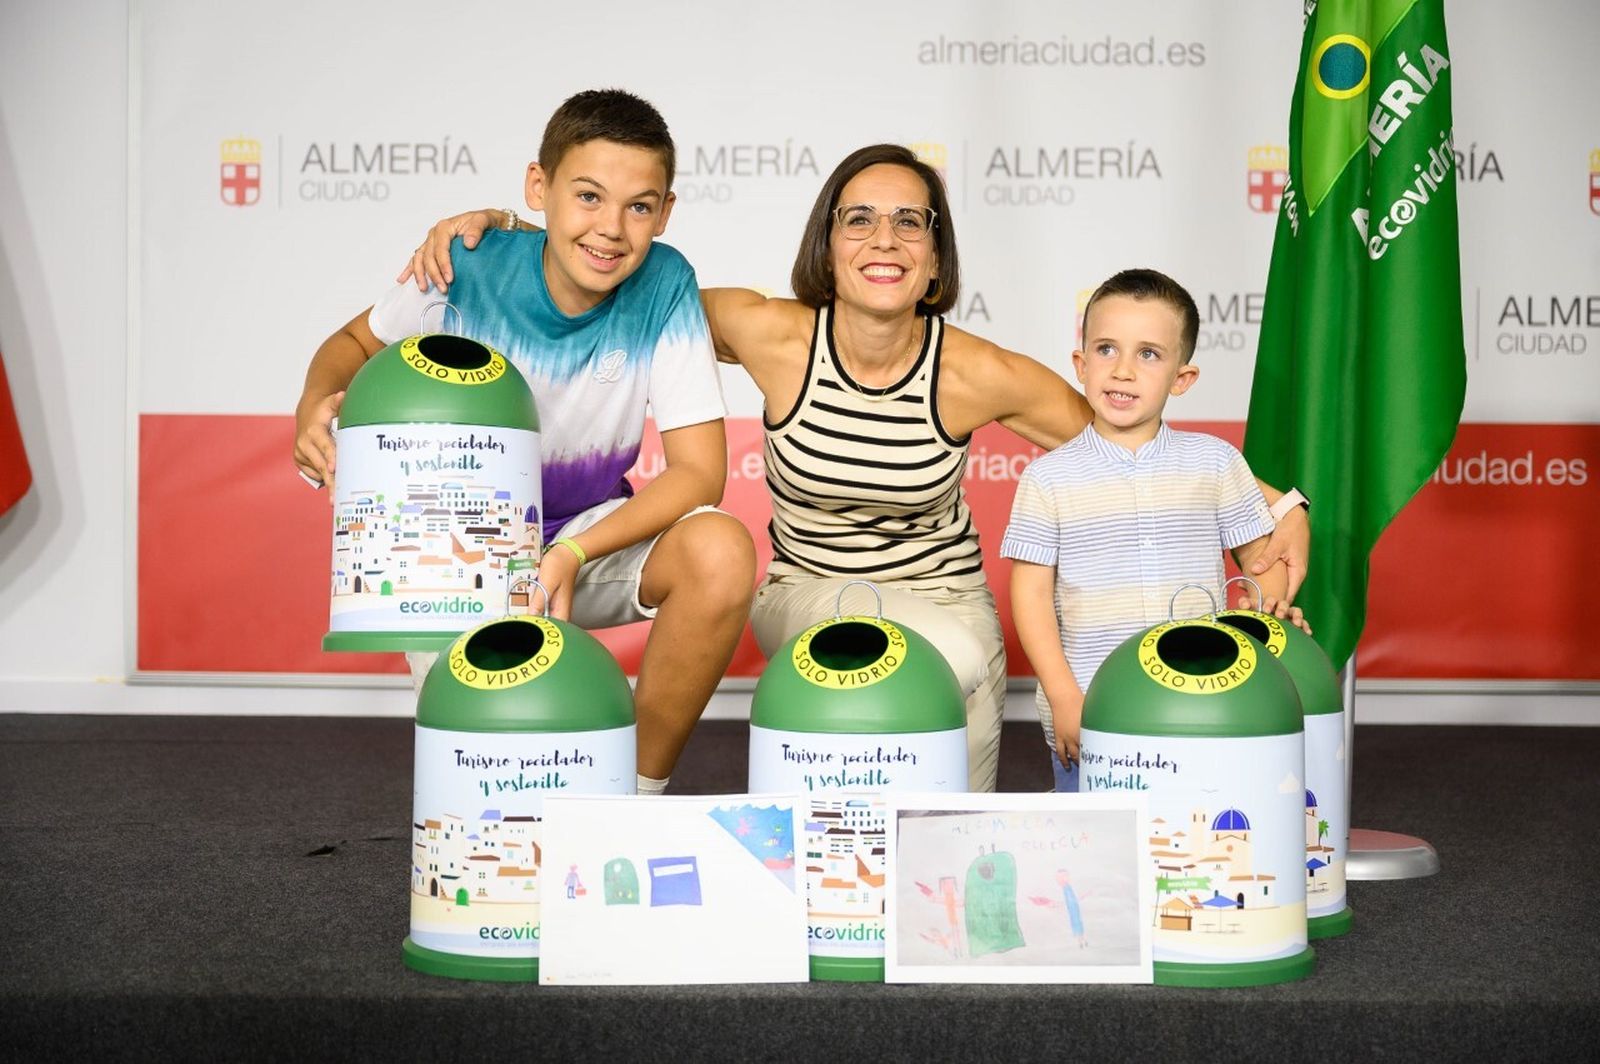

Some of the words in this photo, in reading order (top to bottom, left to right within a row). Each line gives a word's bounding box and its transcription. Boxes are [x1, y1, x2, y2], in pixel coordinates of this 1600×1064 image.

[917, 34, 1206, 67] almeriaciudad.es
[300, 135, 477, 174] ALMERÍA
[985, 139, 1162, 178] ALMERÍA
[299, 179, 390, 202] CIUDAD
[983, 183, 1075, 207] CIUDAD
[1368, 127, 1455, 261] ecovidri
[1496, 332, 1587, 355] CIUDAD
[407, 353, 449, 379] SOLO
[457, 360, 504, 382] VIDRIO
[399, 596, 484, 614] ecovidrio
[486, 654, 550, 686] VIDRIO
[795, 650, 828, 683] SOLO
[837, 655, 898, 686] VIDRIO
[1143, 656, 1186, 688] SOLO
[1196, 658, 1252, 690] VIDRIO
